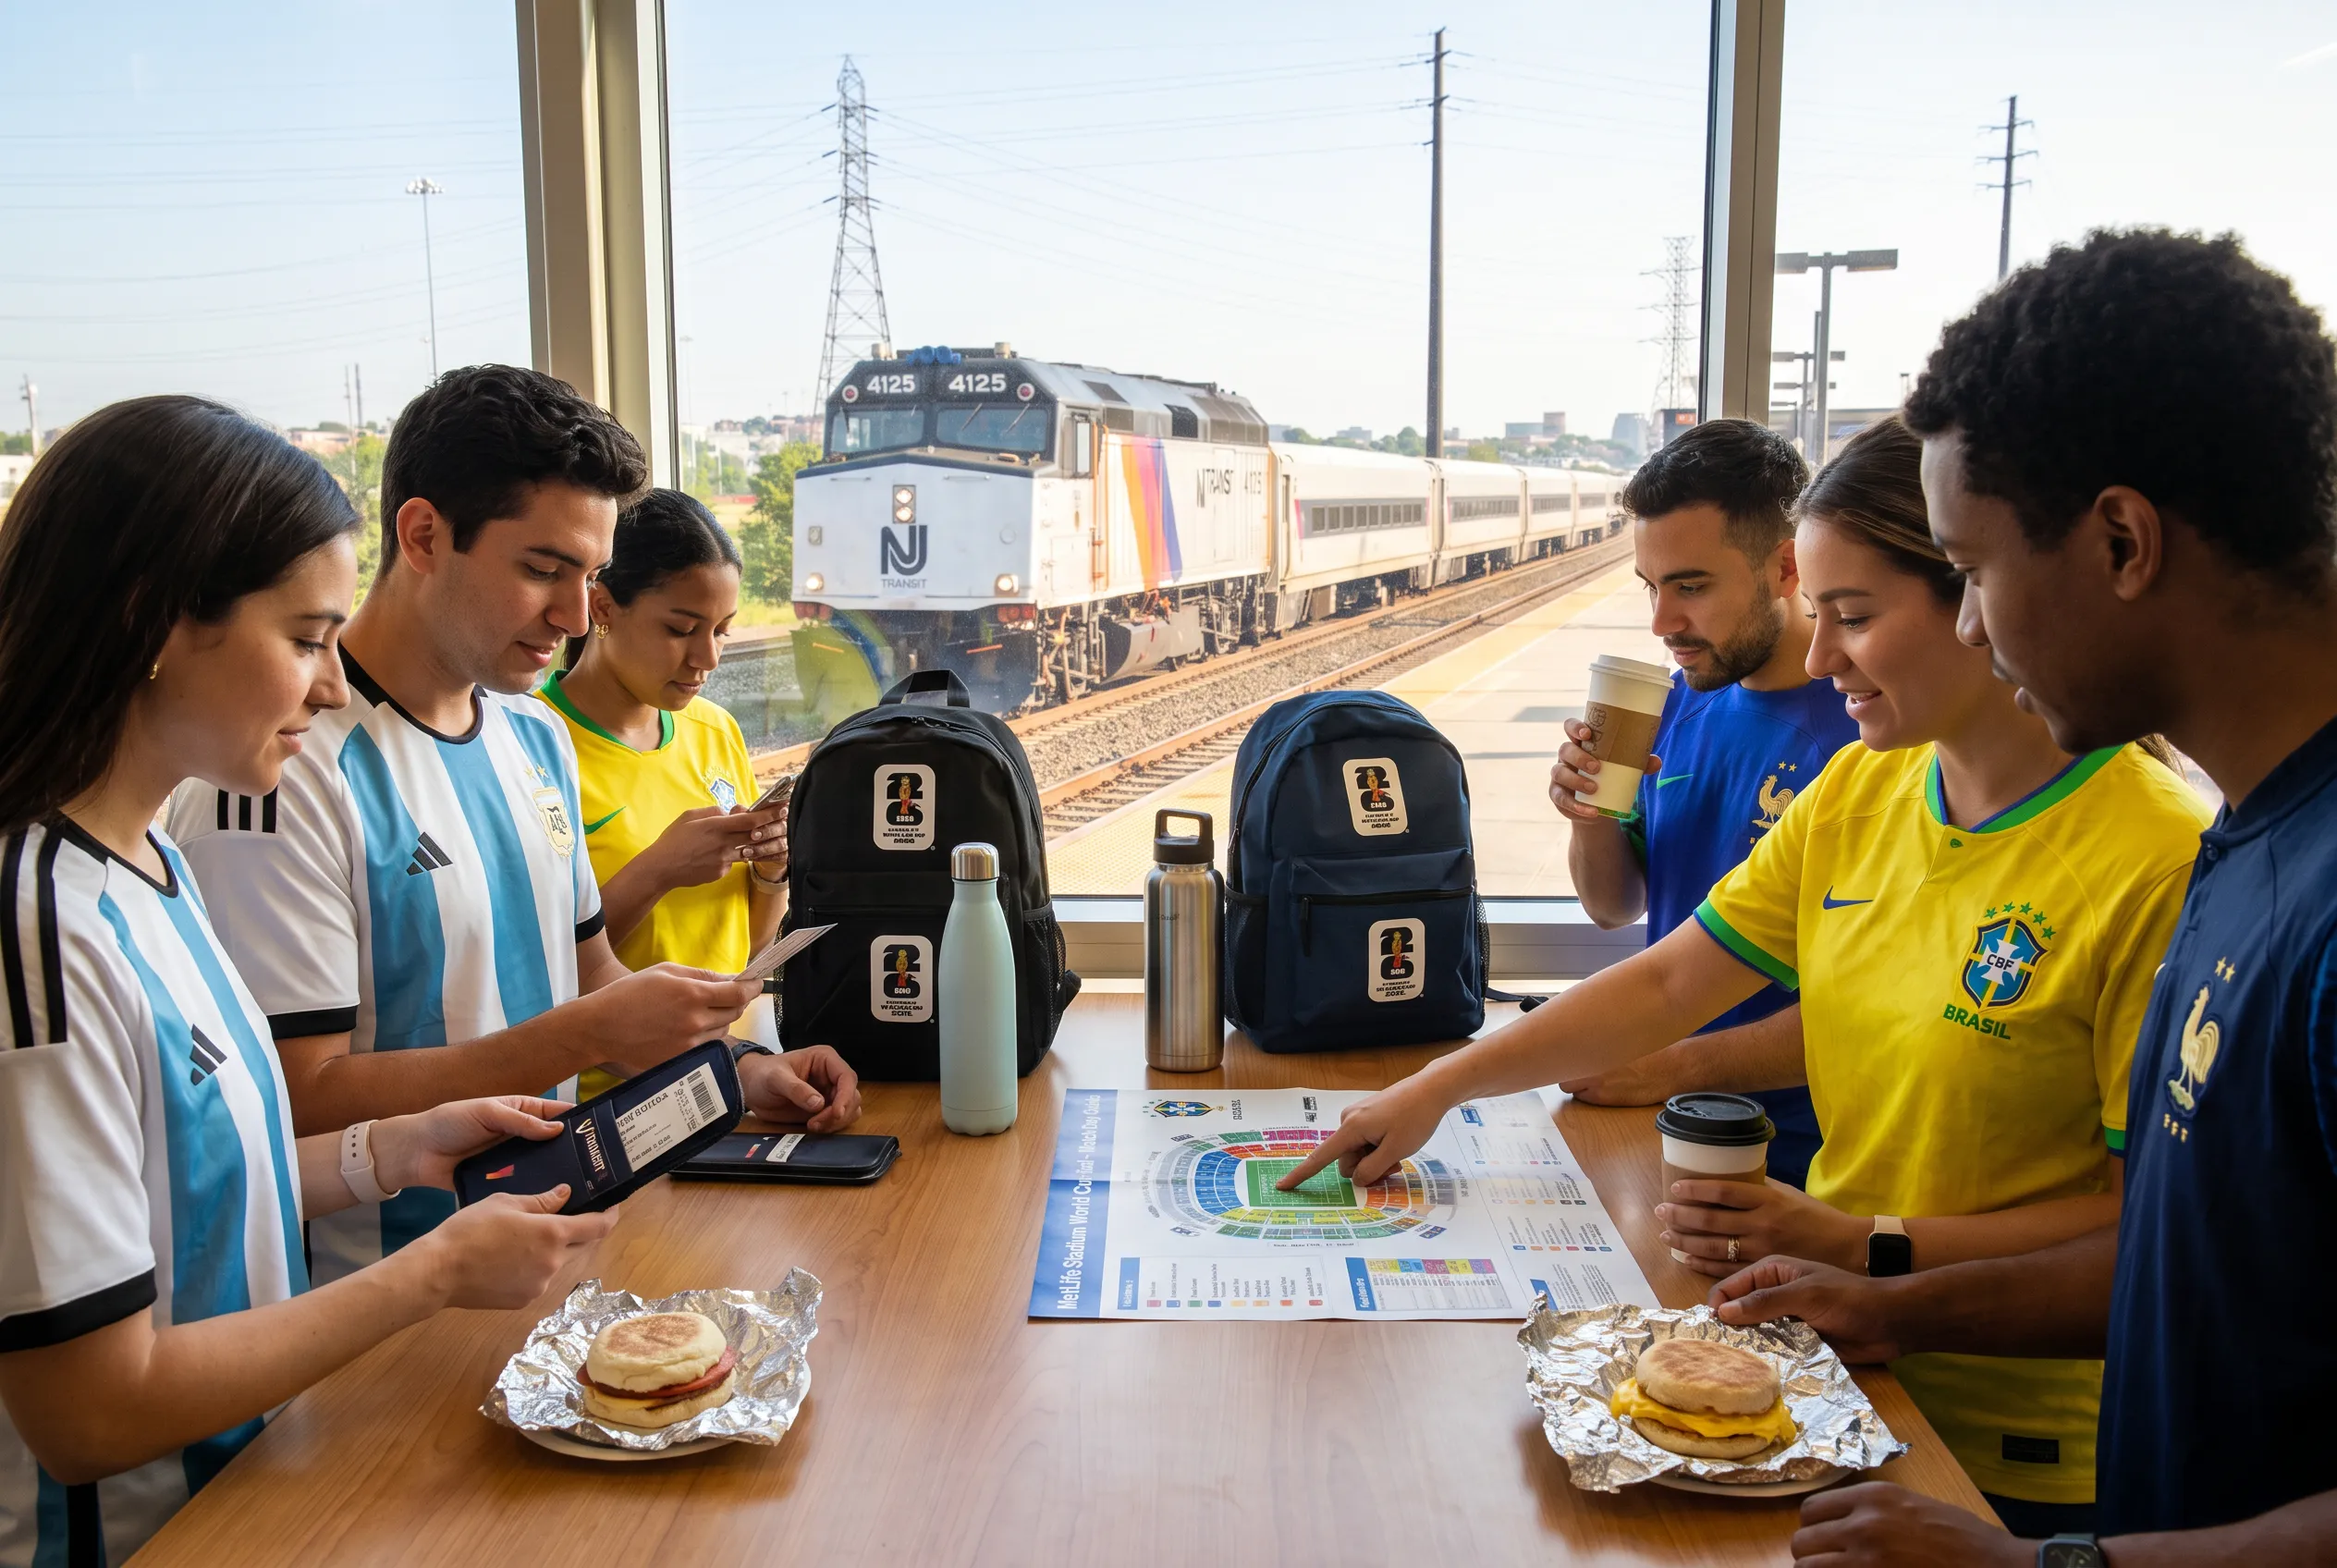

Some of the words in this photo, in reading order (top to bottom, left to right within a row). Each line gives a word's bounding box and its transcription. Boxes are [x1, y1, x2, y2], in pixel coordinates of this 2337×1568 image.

[866, 374, 916, 394] 4125
[948, 374, 1007, 393] 4125
[881, 578, 927, 589] TRANSIT
[1986, 953, 2015, 971] CBF
[1942, 1003, 2012, 1040] BRASIL
[1069, 1196, 1090, 1226] World
[1062, 1227, 1087, 1268] Stadium
[1057, 1269, 1083, 1310] MetLife
